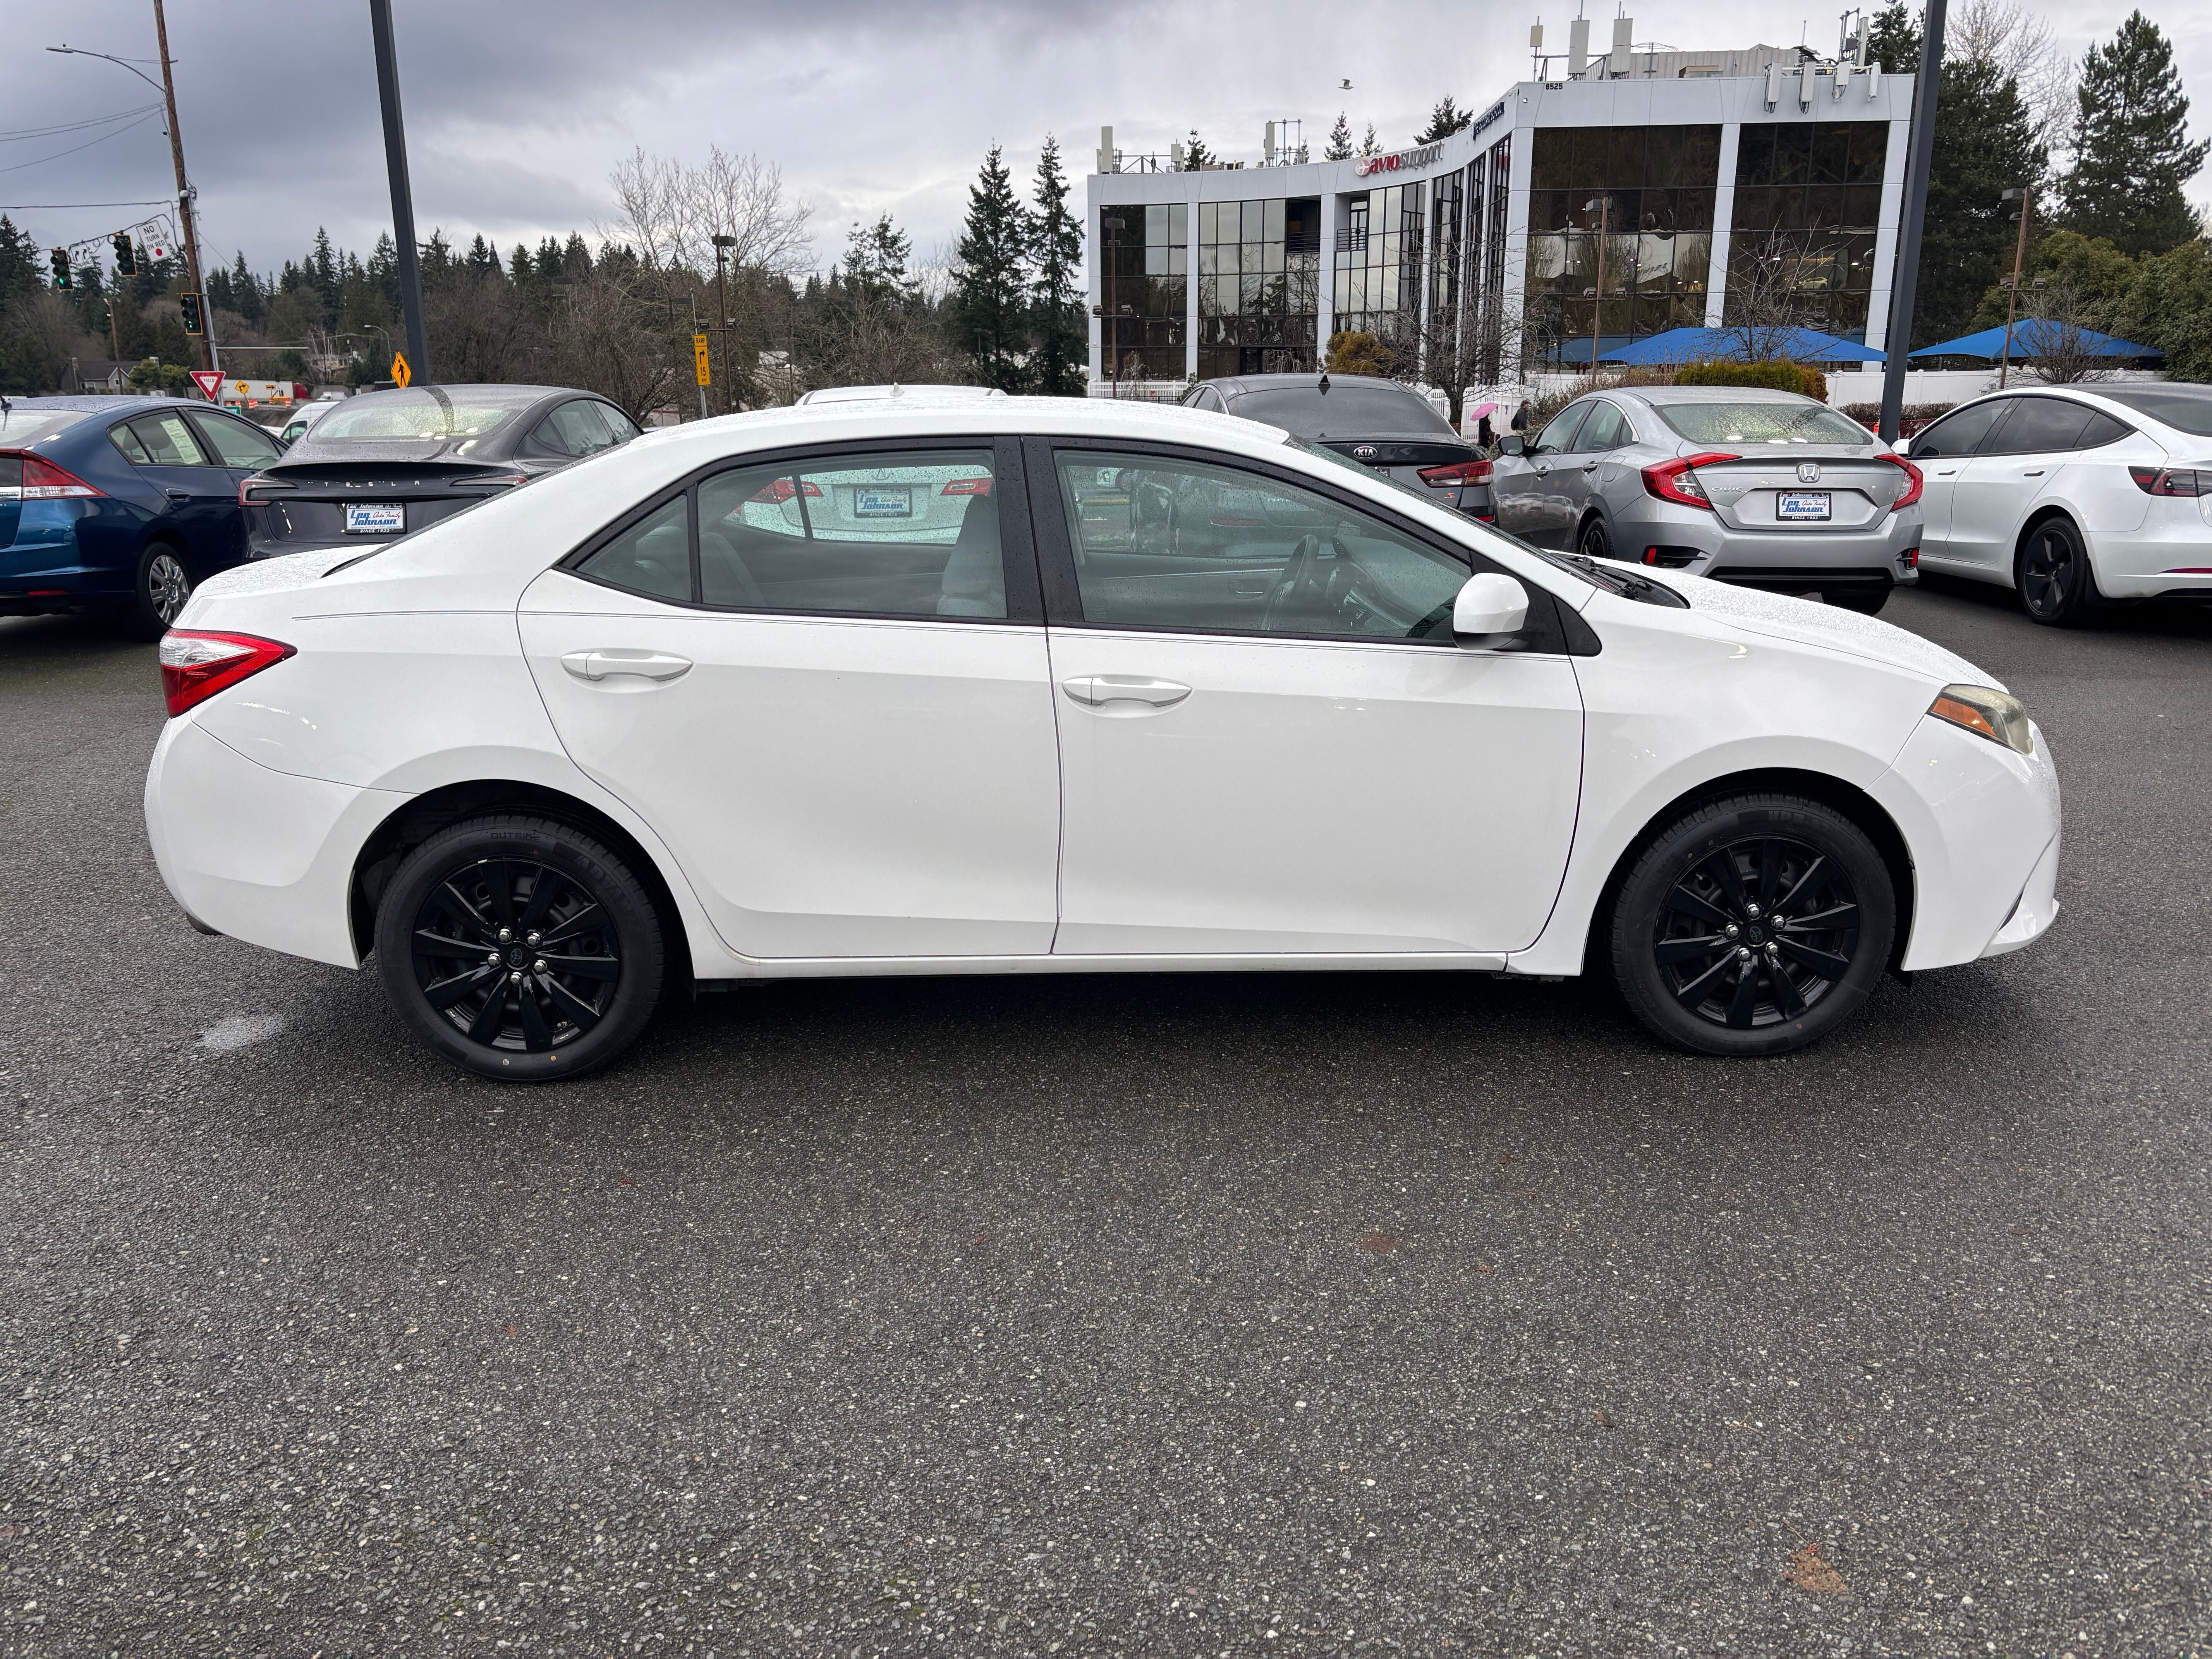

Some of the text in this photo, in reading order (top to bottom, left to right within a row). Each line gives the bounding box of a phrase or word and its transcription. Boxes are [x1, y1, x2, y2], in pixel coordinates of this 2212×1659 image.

[143, 225, 154, 235] NO
[146, 234, 160, 242] TURN
[701, 367, 706, 376] 15
[1782, 497, 1800, 506] Lee
[1813, 500, 1827, 508] Family
[1783, 504, 1824, 512] Johnson
[350, 509, 371, 519] Lee
[351, 515, 397, 526] Johnson
